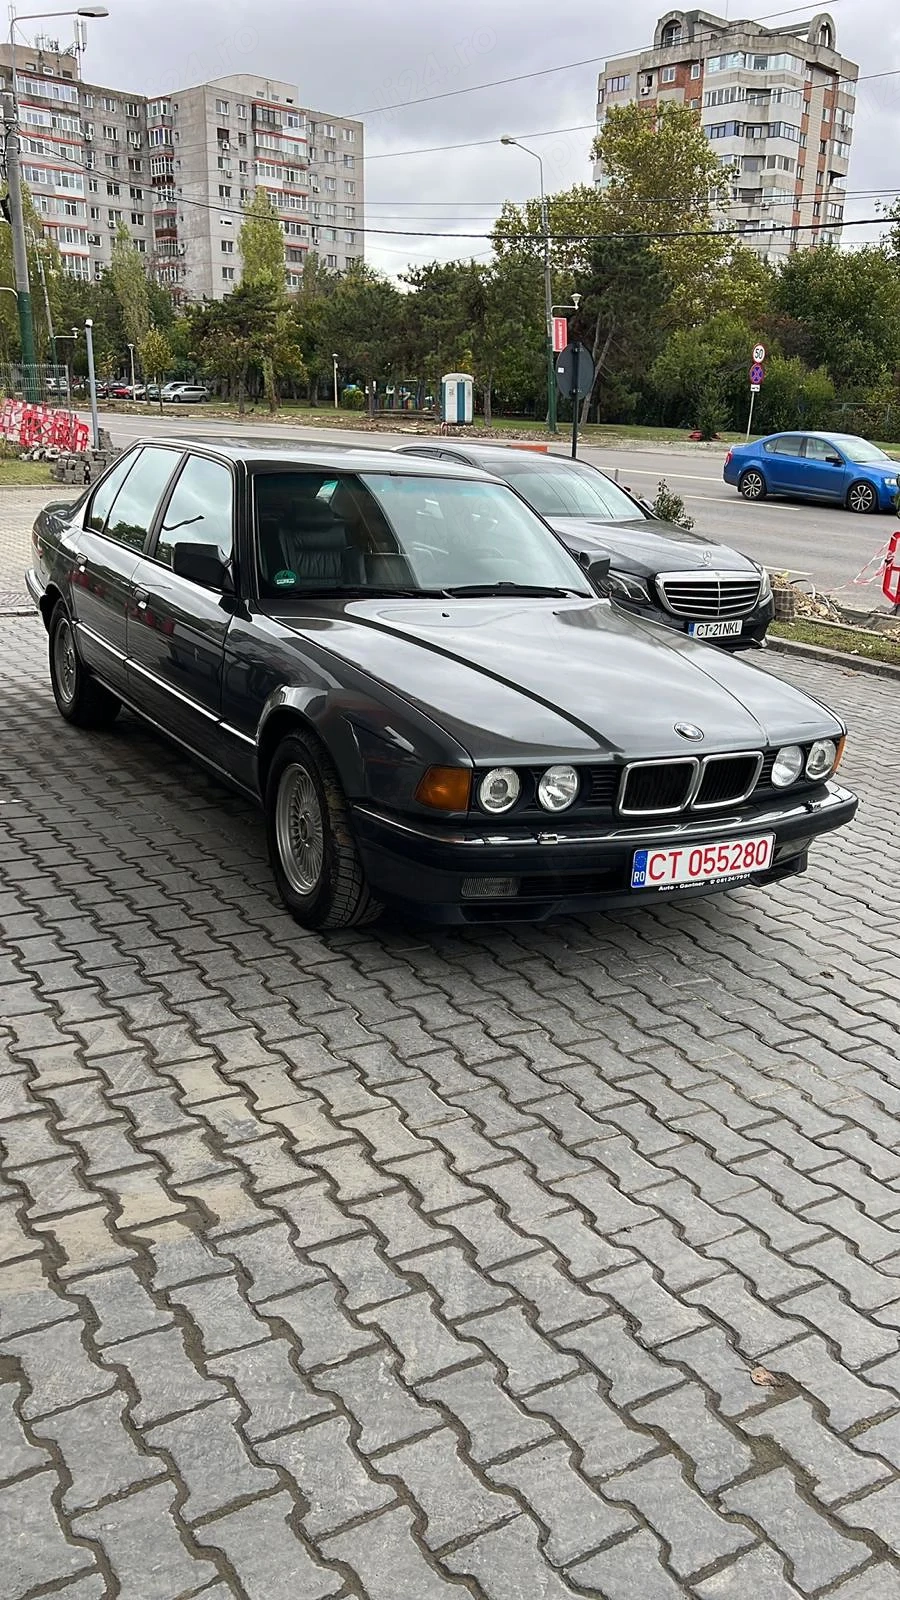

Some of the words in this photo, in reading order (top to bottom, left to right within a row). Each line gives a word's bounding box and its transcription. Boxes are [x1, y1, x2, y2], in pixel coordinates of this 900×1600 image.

[754, 348, 764, 360] 50
[696, 624, 710, 636] CT
[649, 851, 683, 881] CT
[688, 839, 769, 876] 055280
[633, 870, 645, 883] RO
